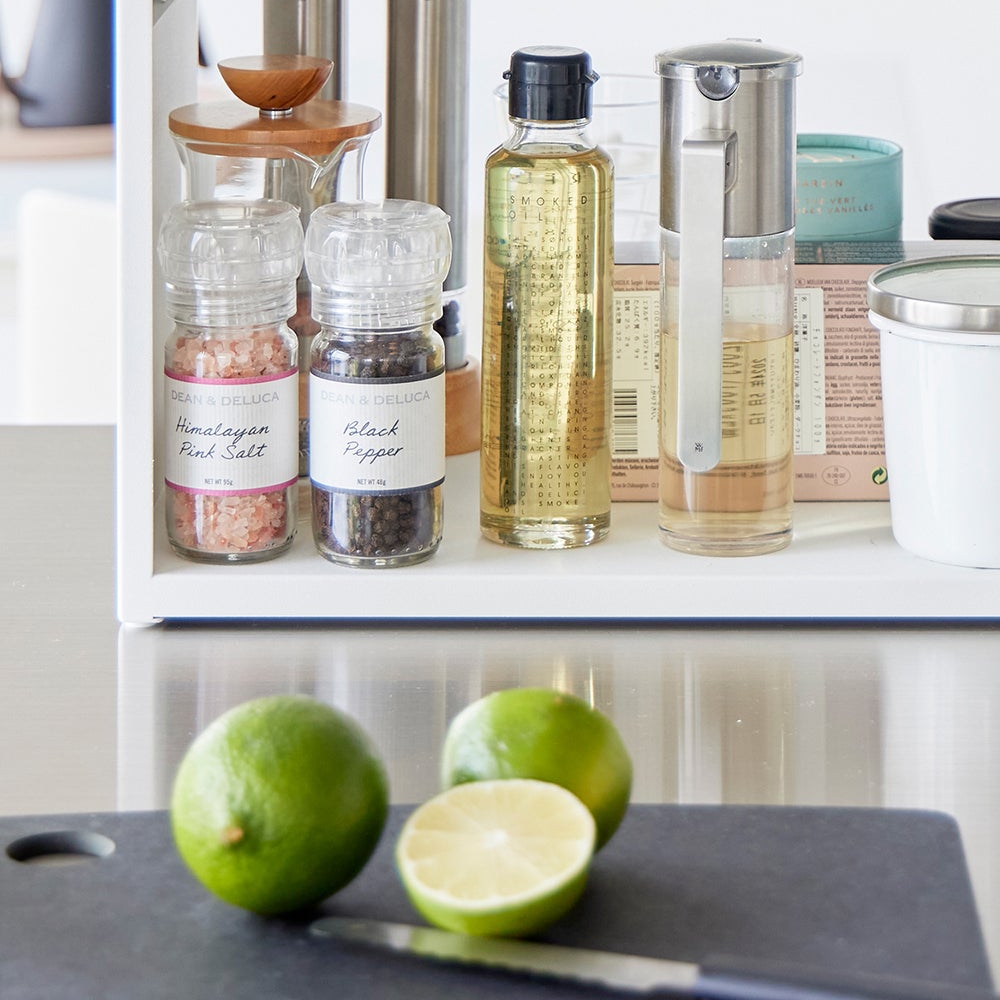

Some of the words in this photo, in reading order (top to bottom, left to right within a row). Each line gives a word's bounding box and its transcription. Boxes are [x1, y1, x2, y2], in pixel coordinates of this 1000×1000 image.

[510, 196, 587, 205] SMOKED
[509, 210, 543, 221] OIL
[171, 389, 202, 405] DEAN
[207, 396, 216, 405] &
[221, 392, 279, 406] DELUCA
[321, 390, 355, 405] DEAN
[358, 395, 369, 405] &
[374, 390, 431, 406] DELUCA
[176, 416, 270, 445] Himalayan
[343, 419, 400, 436] Black
[179, 441, 215, 459] Pink
[221, 443, 267, 460] Salt
[343, 442, 404, 464] Pepper
